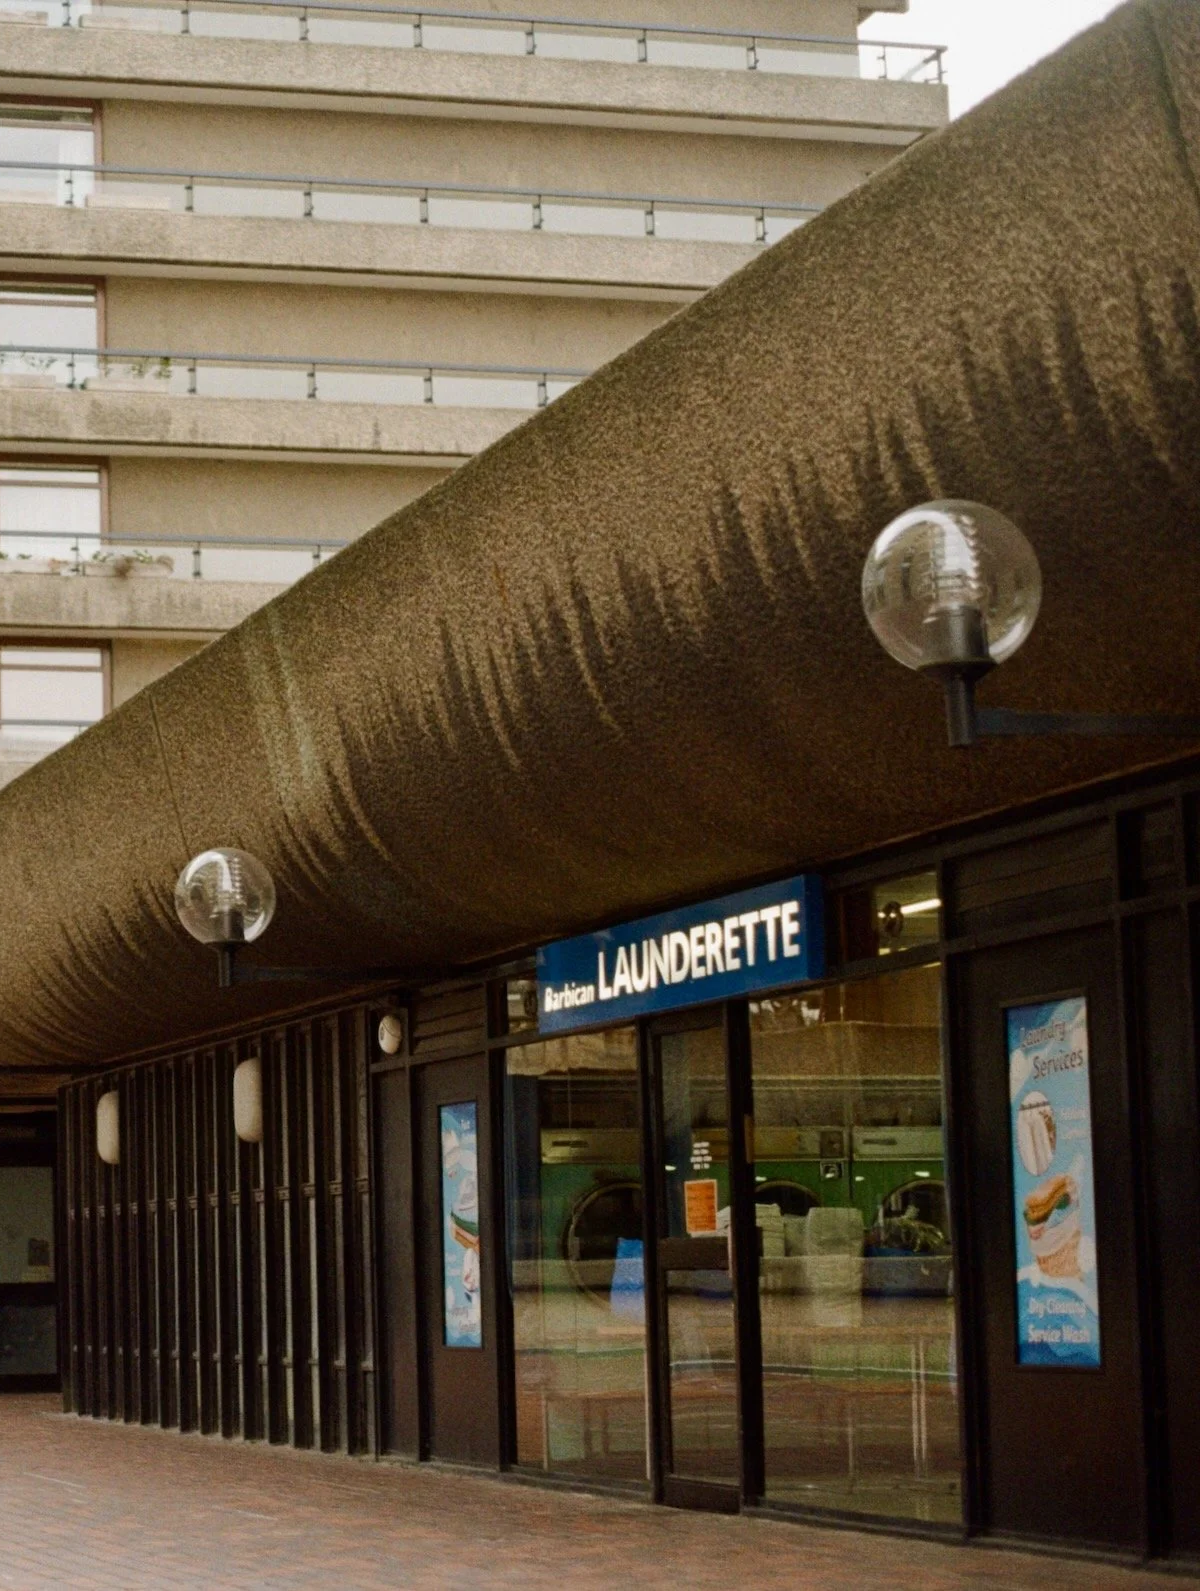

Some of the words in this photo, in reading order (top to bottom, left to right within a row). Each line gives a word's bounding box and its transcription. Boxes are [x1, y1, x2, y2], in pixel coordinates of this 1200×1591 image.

[545, 982, 595, 1013] Barbican
[598, 900, 800, 1000] LAUNDERETTE
[1020, 1018, 1066, 1049] Laundry
[1033, 1049, 1083, 1079] Services
